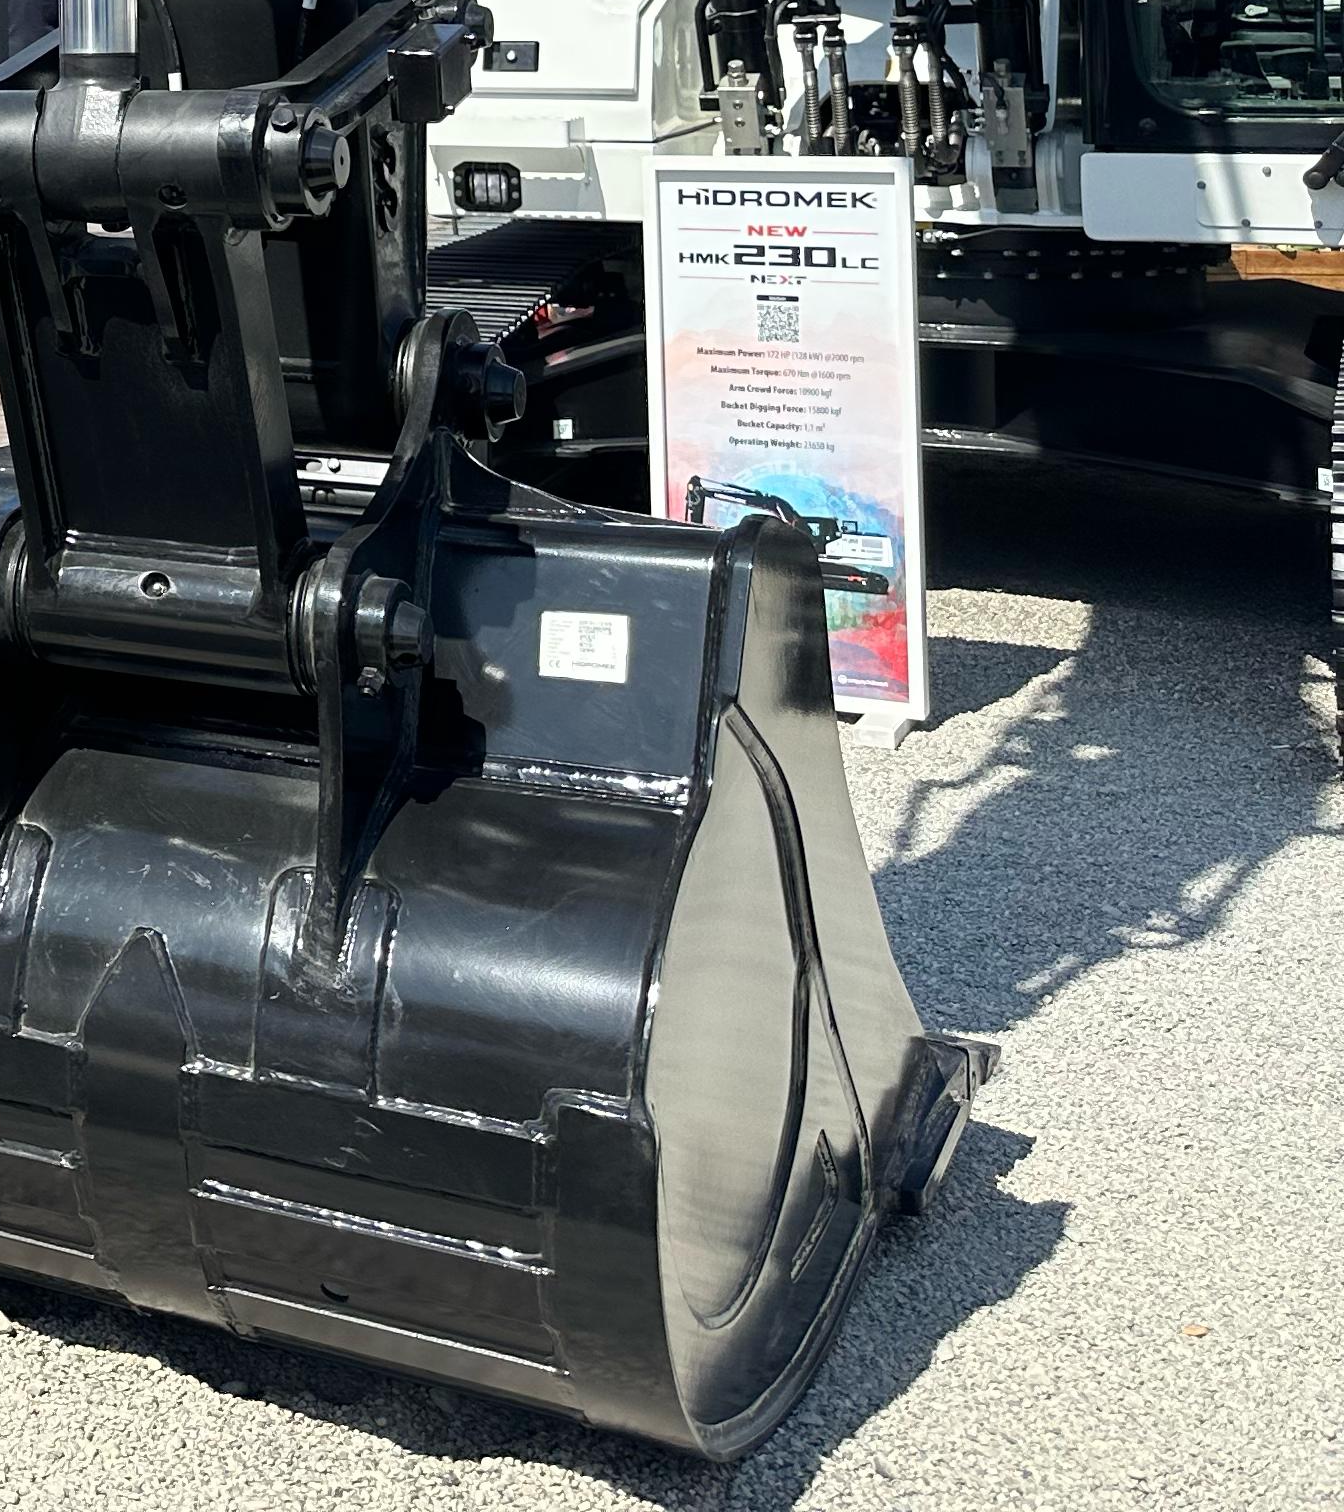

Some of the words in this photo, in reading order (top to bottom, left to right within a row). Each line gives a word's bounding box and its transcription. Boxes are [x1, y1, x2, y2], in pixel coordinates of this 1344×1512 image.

[747, 225, 808, 237] NEW
[678, 252, 729, 264] HMK
[733, 244, 836, 268] 230
[841, 257, 879, 269] LC
[750, 274, 807, 285] NEXT
[697, 346, 736, 357] Maximum
[711, 366, 750, 374] Maximum
[751, 367, 781, 378] Torque:
[729, 384, 745, 392] Arm
[747, 385, 772, 393] Crowd
[721, 401, 747, 410] Bucket
[750, 403, 781, 413] Digging
[783, 405, 806, 413] Force:
[737, 419, 764, 428] Bucket
[766, 421, 802, 432] Capacity:
[729, 436, 768, 448] Operating
[770, 437, 802, 449] Weight:
